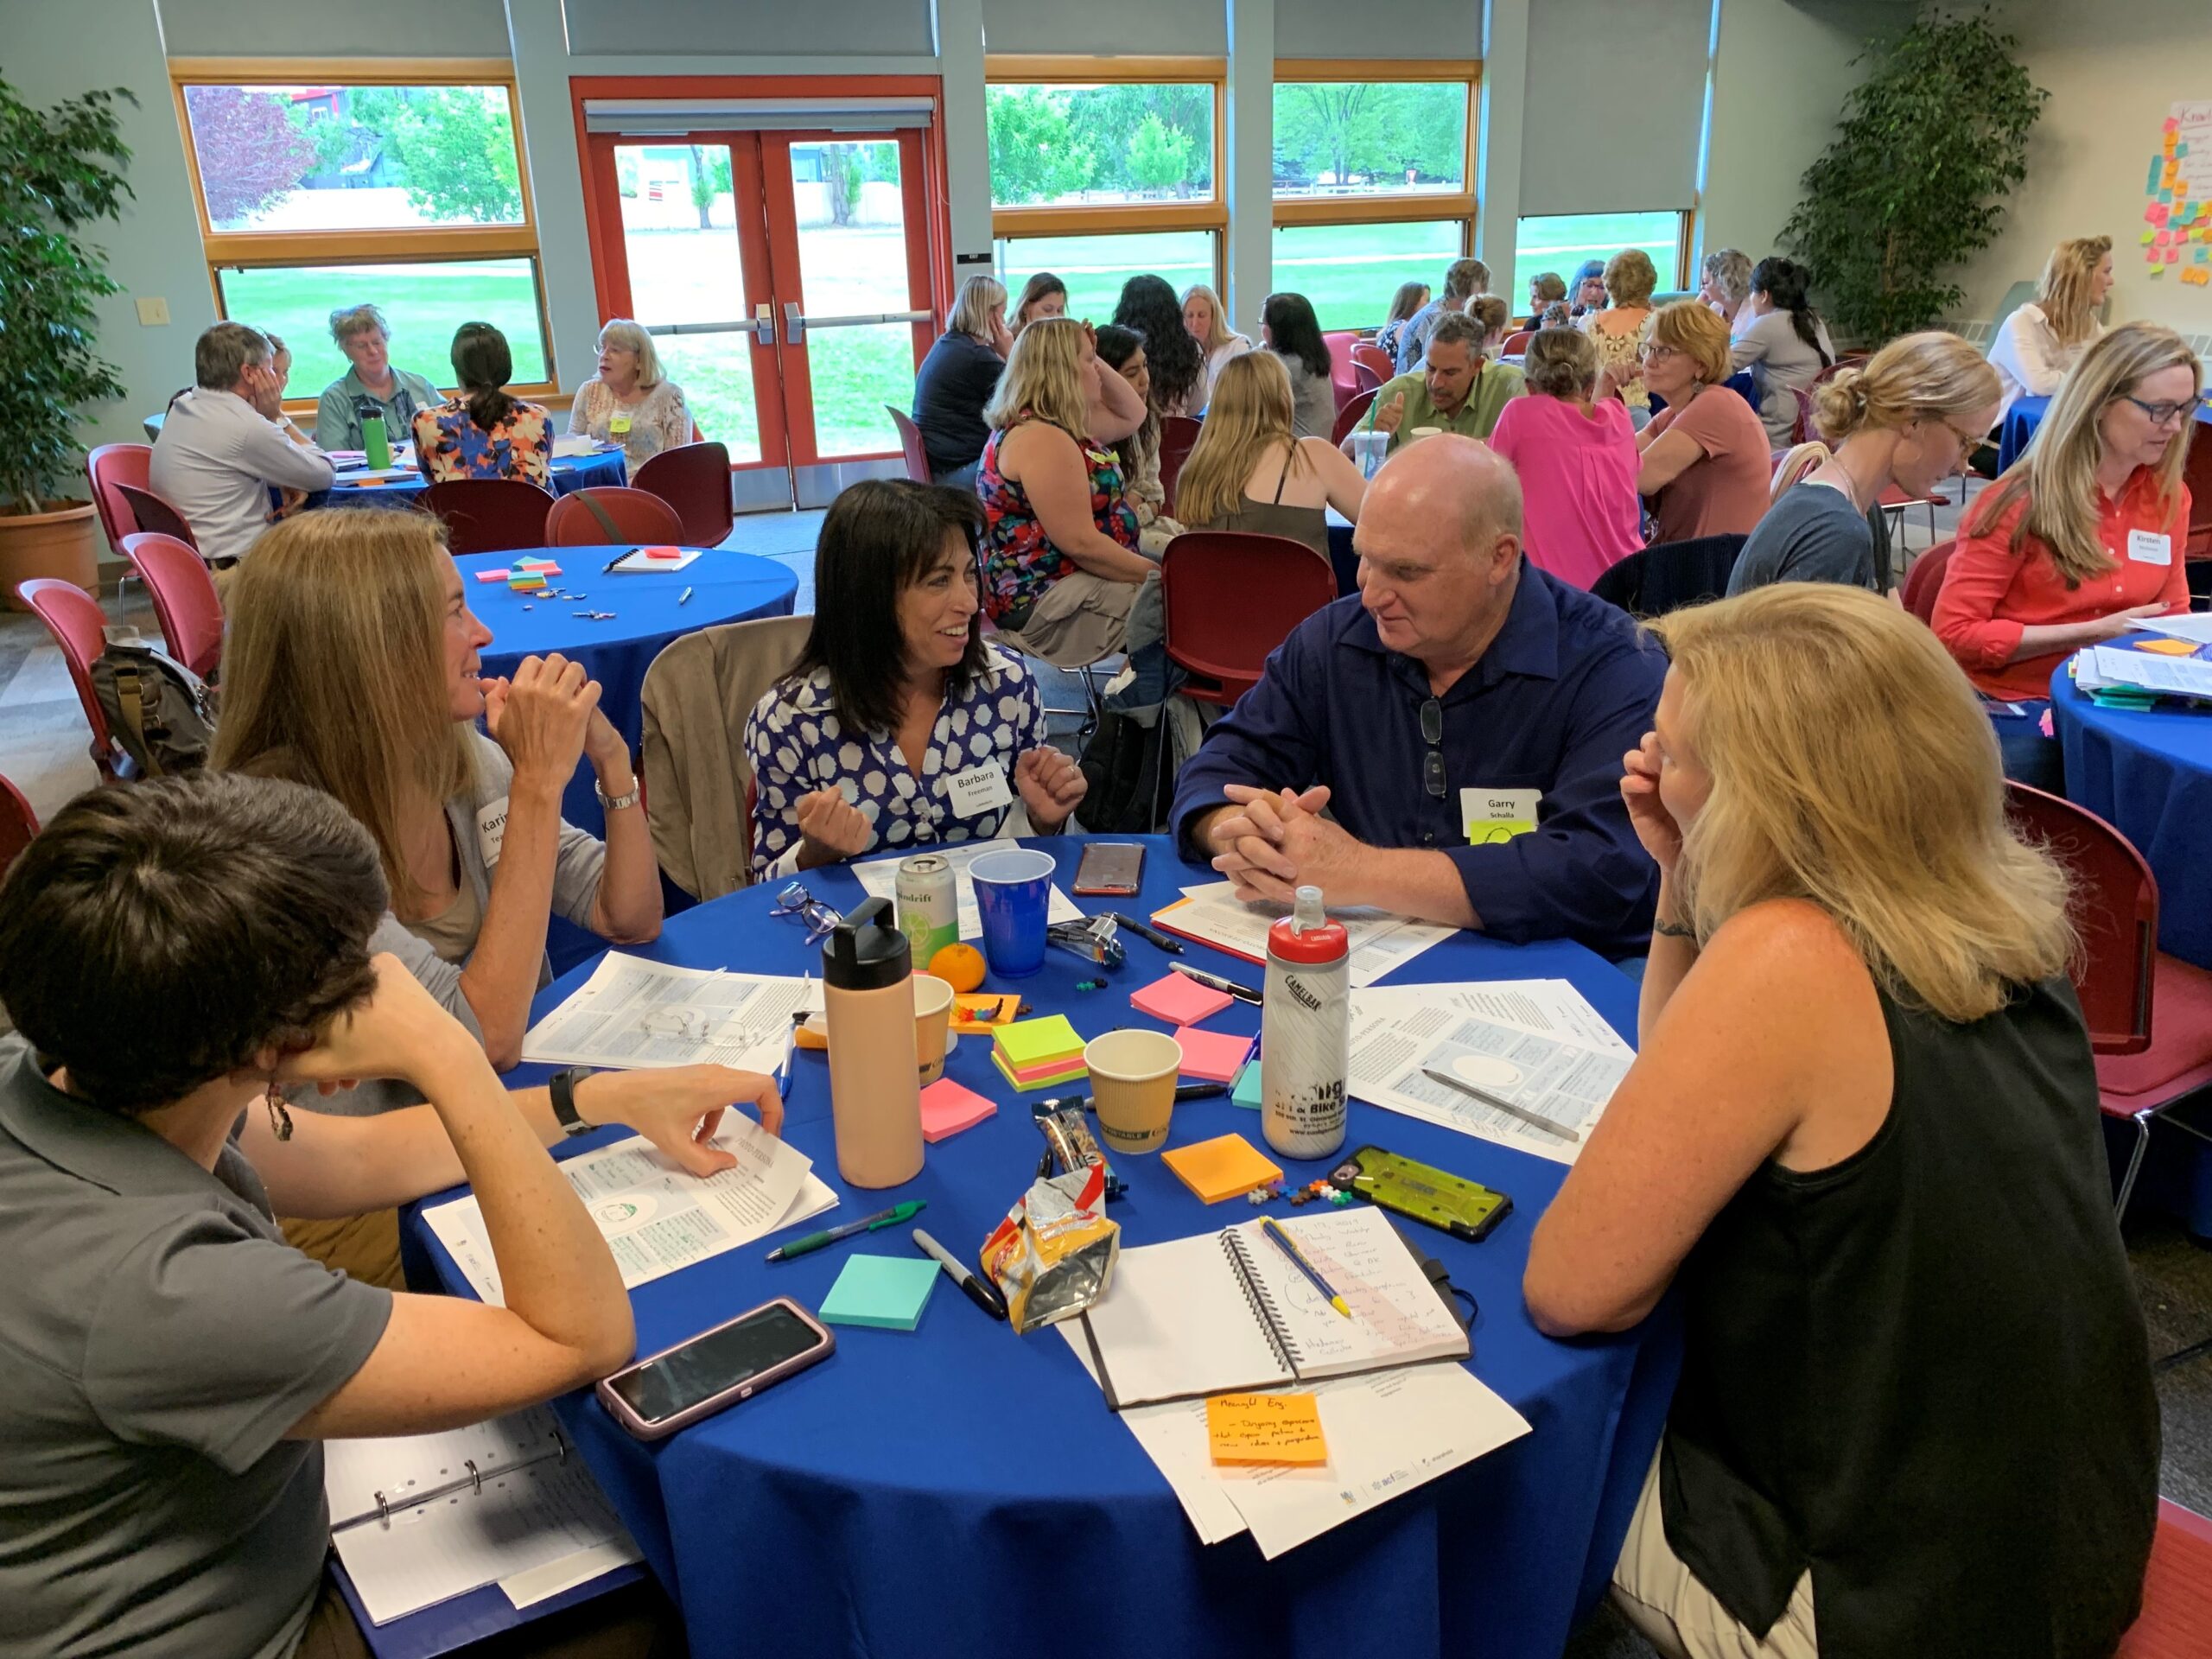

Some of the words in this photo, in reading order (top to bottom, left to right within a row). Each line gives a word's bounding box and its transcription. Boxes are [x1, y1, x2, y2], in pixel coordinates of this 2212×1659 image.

[2136, 535, 2161, 545] Kirsten
[957, 771, 995, 789] Barbara
[967, 785, 994, 798] Freeman
[1488, 799, 1516, 809] Garry
[897, 891, 931, 902] pindrift
[1285, 975, 1320, 1012] CAMELBAK
[1310, 1102, 1336, 1114] Bike
